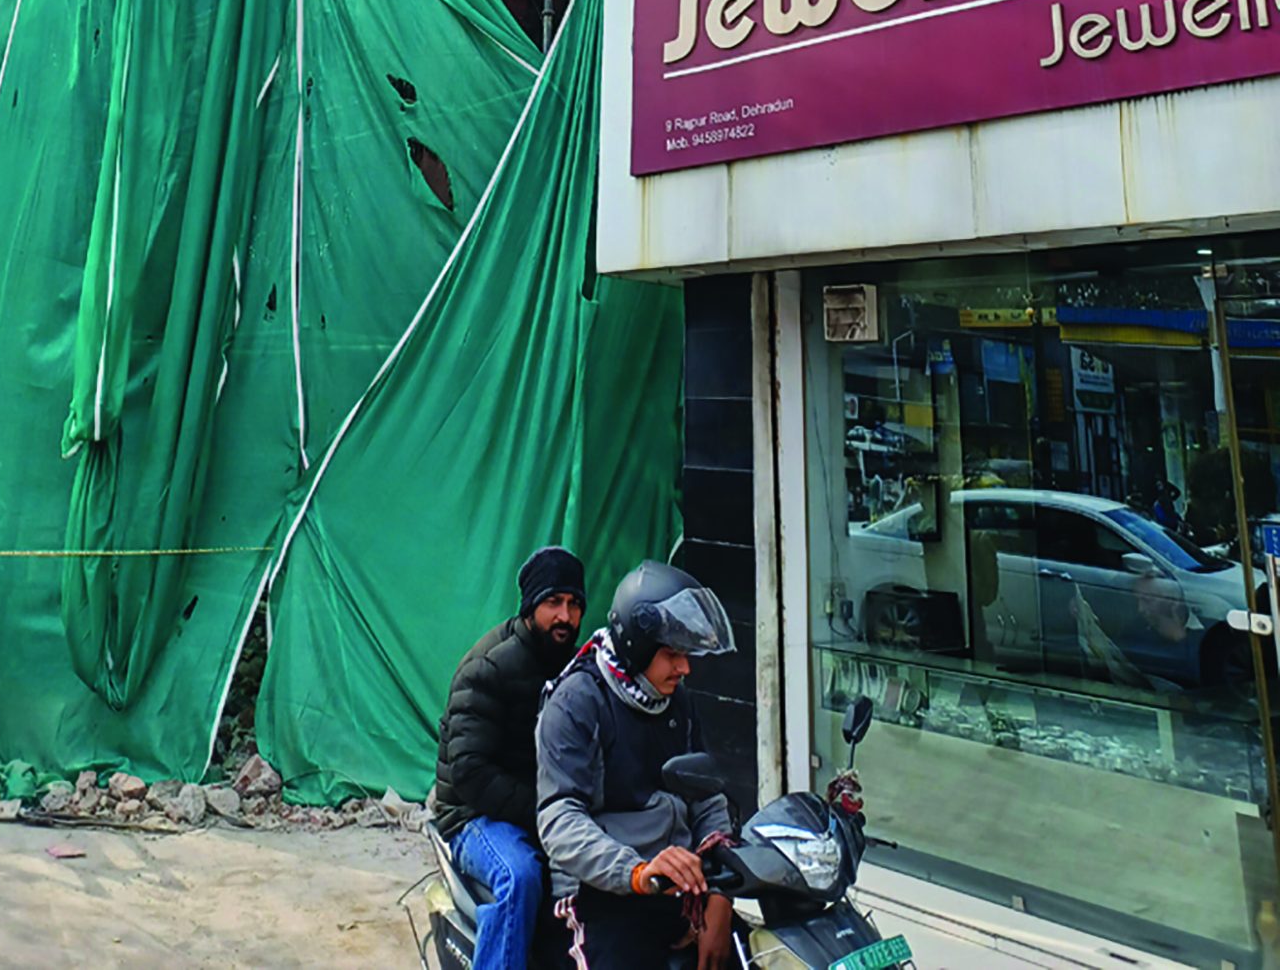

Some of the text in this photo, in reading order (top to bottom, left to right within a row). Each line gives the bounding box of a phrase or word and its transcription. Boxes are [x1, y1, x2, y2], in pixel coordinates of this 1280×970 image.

[665, 98, 794, 132] 9 Rajpur Road, Dehradun
[666, 137, 689, 151] Mob.
